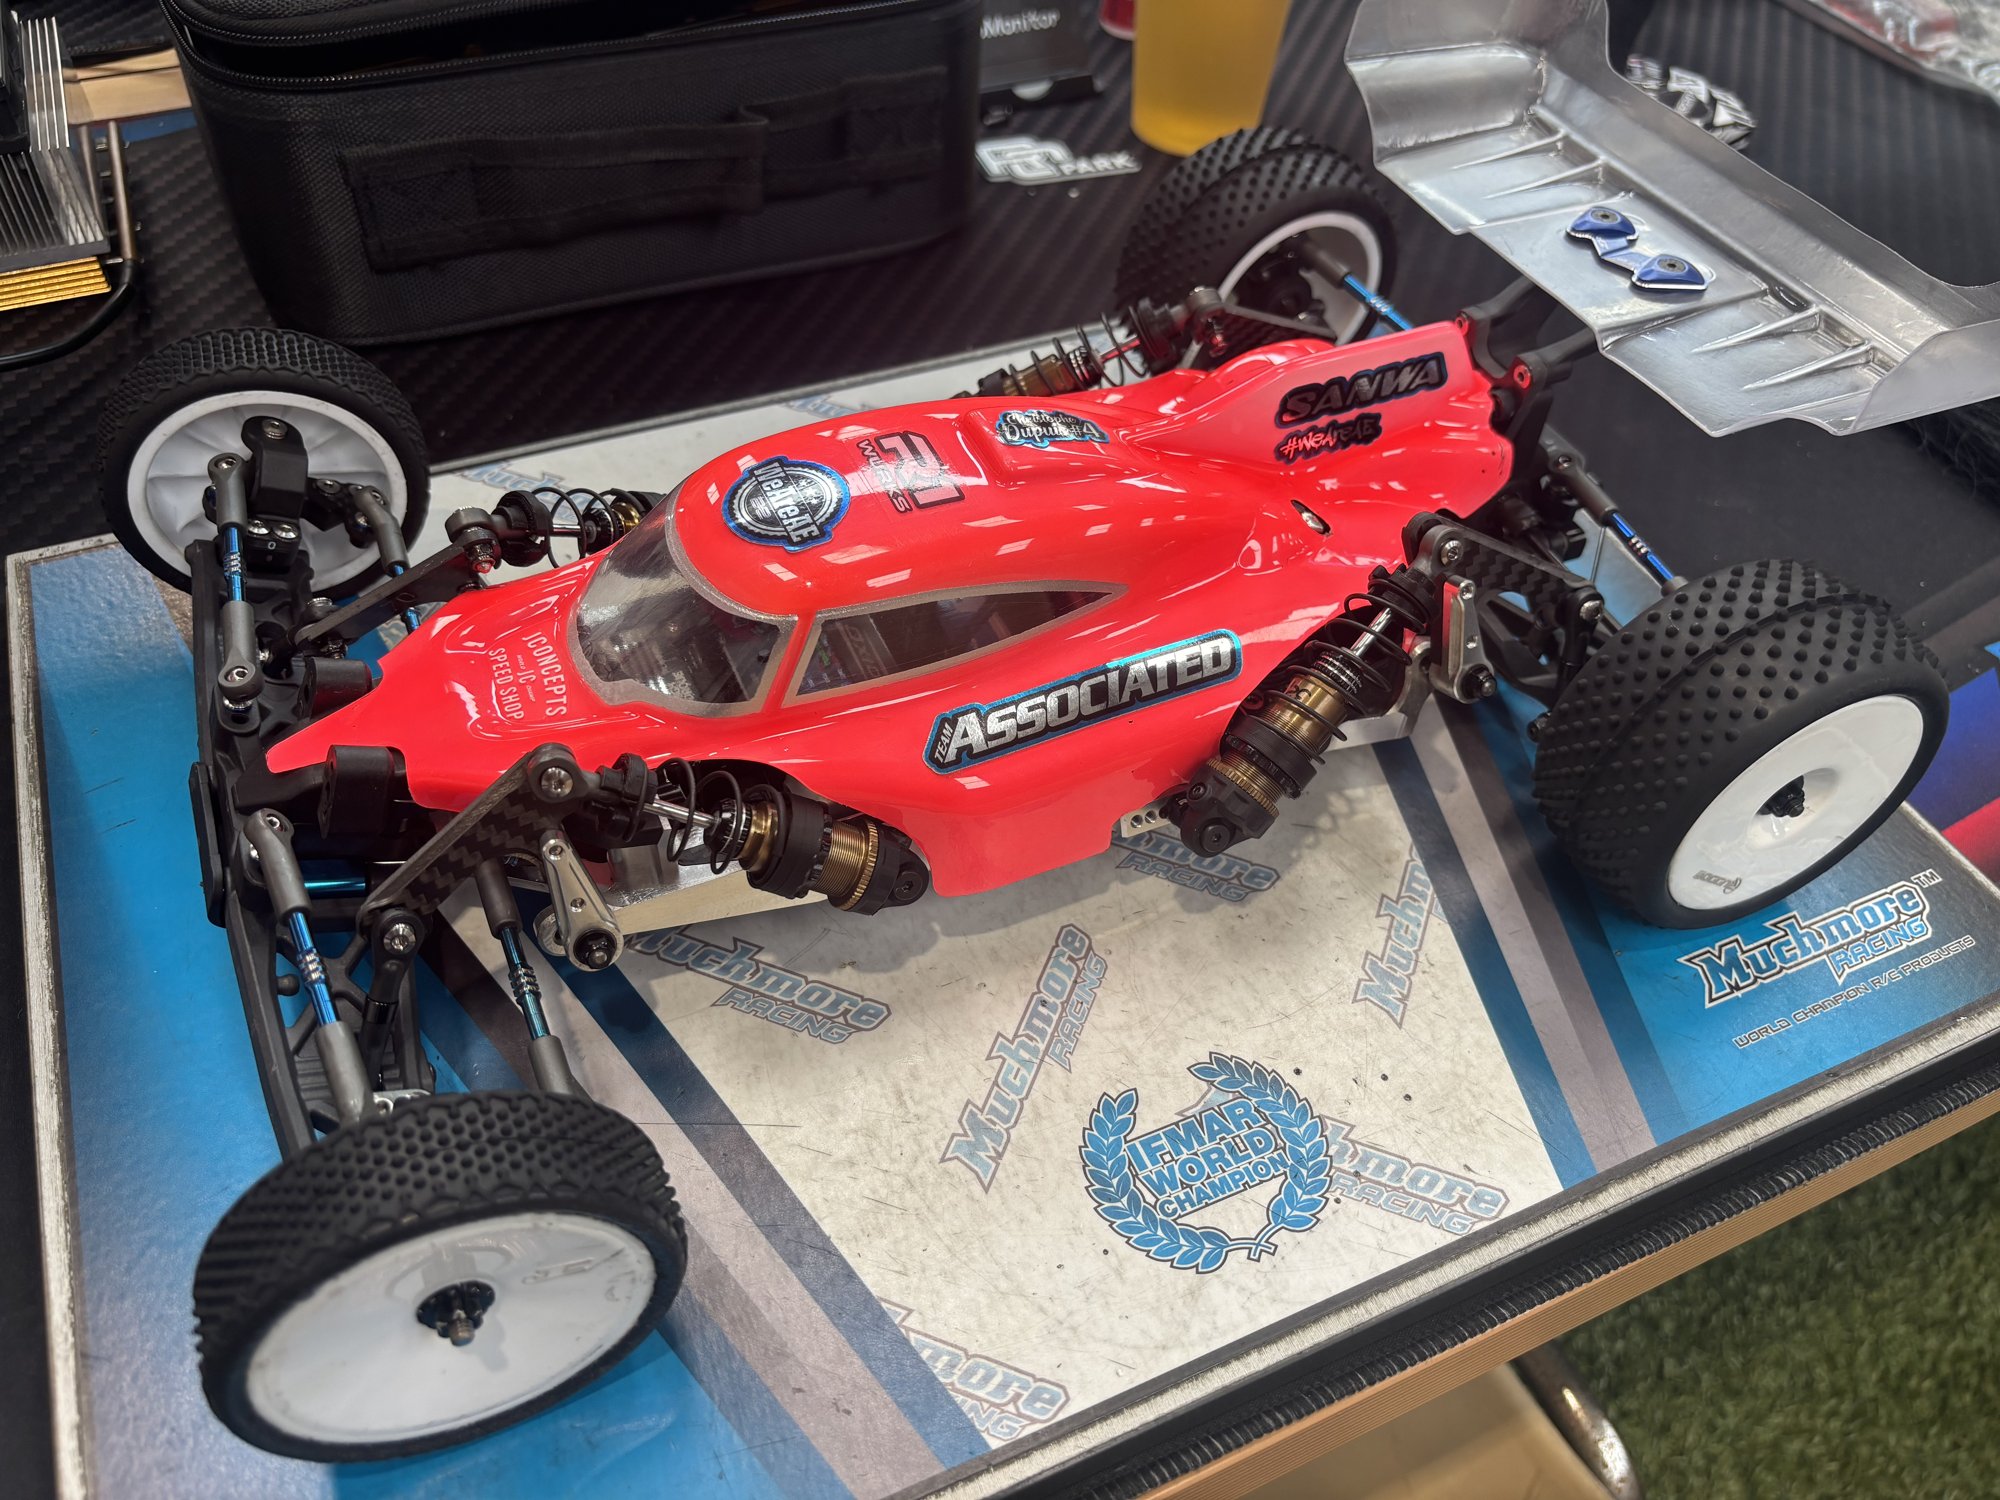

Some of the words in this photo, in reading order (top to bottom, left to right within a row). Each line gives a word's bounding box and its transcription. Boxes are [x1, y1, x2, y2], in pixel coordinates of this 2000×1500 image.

[980, 9, 1060, 39] Monitor
[1060, 152, 1139, 176] PARK
[1282, 358, 1441, 423] SANWA
[752, 461, 822, 543] WeAreAE
[489, 648, 514, 684] SPEED
[517, 670, 536, 684] JC
[522, 631, 567, 716] JCONCEPTS
[500, 686, 524, 719] SHOP
[934, 722, 954, 763] TEAM
[945, 637, 1233, 763] ASSOCIATED
[1119, 853, 1249, 900] RACING
[1690, 885, 1926, 1003] Muchmore
[1829, 916, 1929, 976] RACING
[716, 988, 853, 1043] RACING
[1049, 954, 1106, 1070] RACING
[1733, 1019, 1792, 1048] WORLD
[1871, 969, 1901, 990] R/C
[1900, 935, 1976, 977] PRODUCTS
[944, 925, 1090, 1187] Muchmore
[1125, 1099, 1266, 1173] IFMAR
[1141, 1127, 1275, 1197] WORLD
[1157, 1150, 1290, 1219] CHAMPION
[1330, 1173, 1478, 1234] RACING
